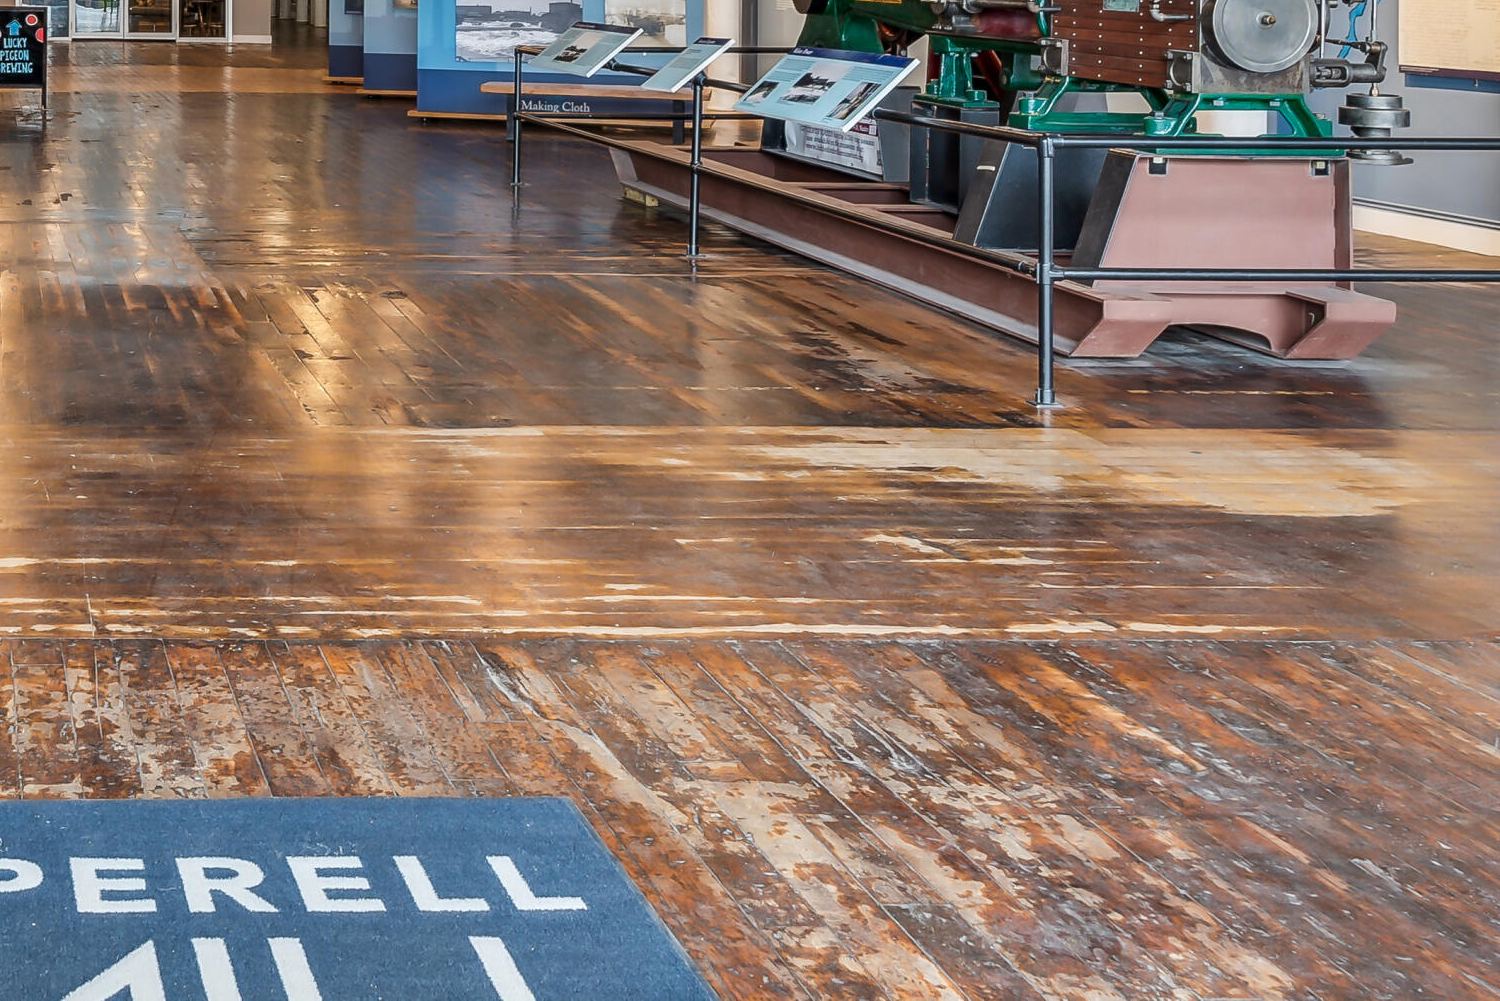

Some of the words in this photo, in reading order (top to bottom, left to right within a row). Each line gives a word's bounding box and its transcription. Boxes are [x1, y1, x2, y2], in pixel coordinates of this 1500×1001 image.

[3, 38, 28, 49] LUCKY
[0, 49, 30, 61] PIGEON
[521, 100, 560, 113] Making
[561, 101, 591, 113] Cloth
